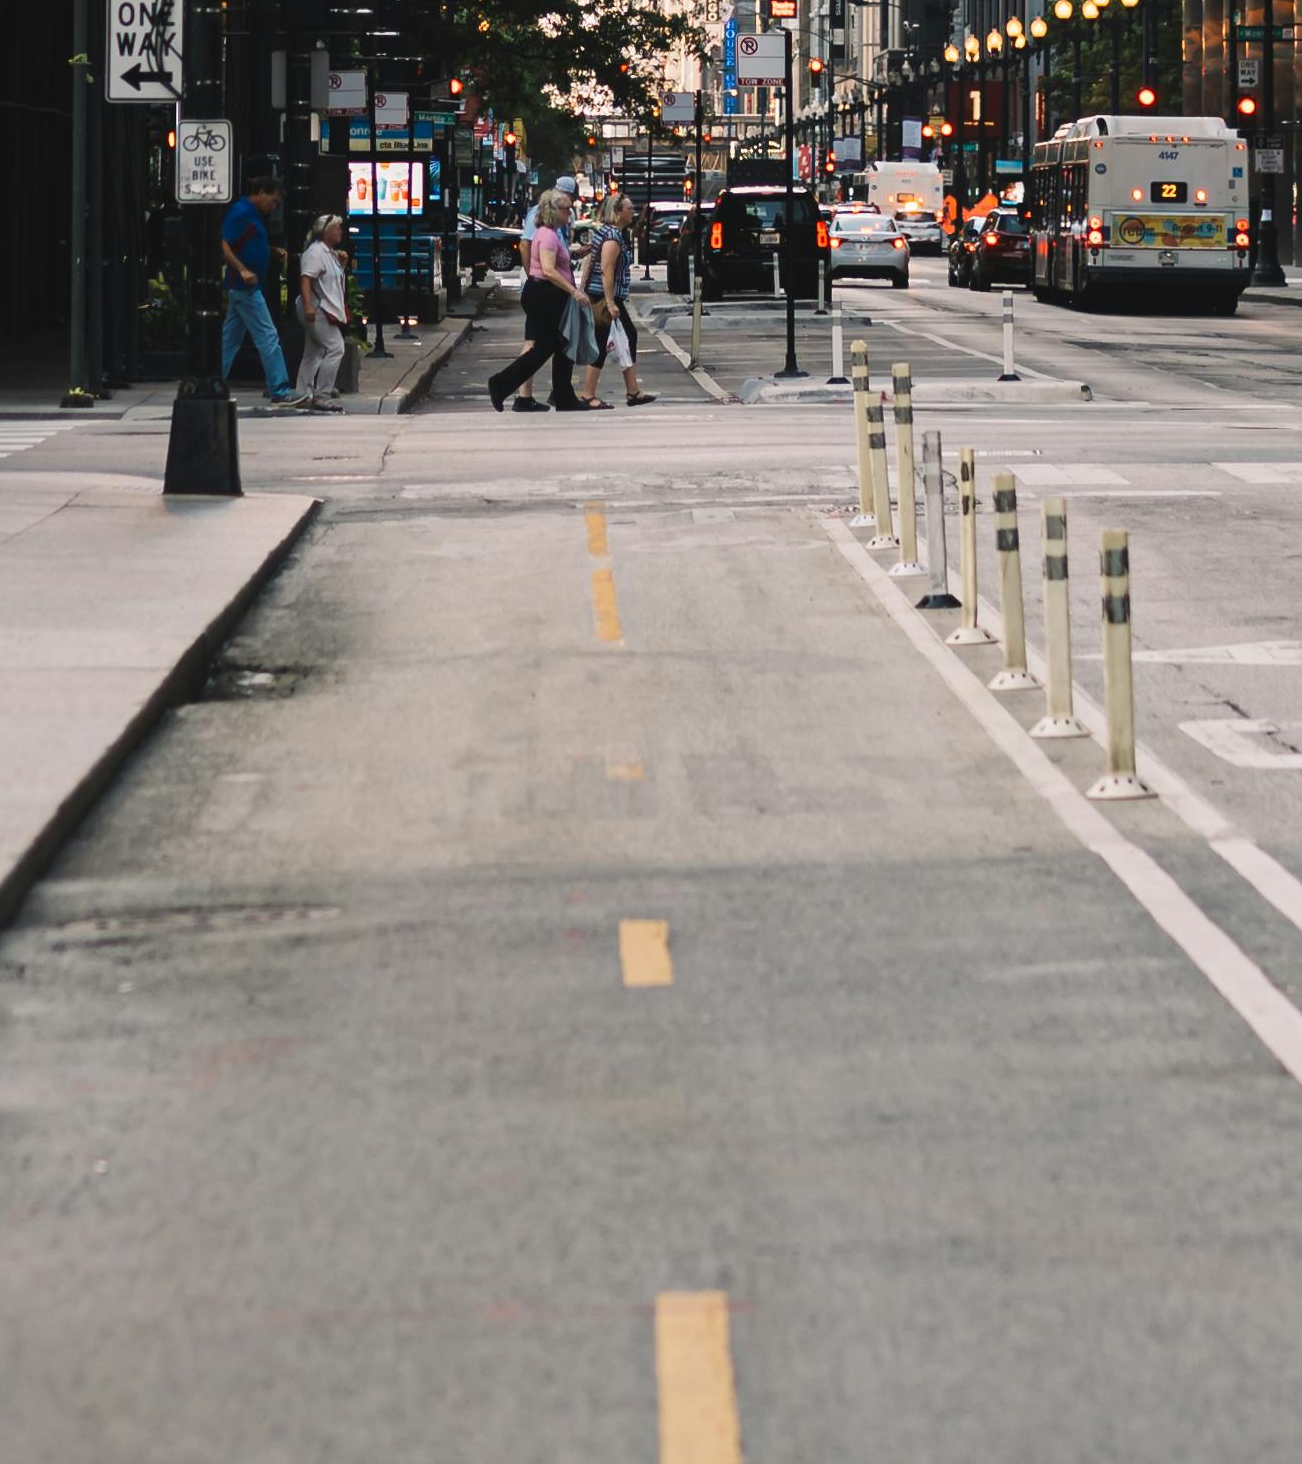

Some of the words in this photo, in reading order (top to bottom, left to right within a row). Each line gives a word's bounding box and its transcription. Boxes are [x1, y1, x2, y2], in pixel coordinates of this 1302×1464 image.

[118, 2, 175, 27] ONE
[116, 32, 176, 57] WAY
[725, 20, 735, 67] HOUSE
[741, 78, 758, 86] TOW
[762, 78, 784, 86] ZONE
[194, 156, 214, 167] USE
[1158, 151, 1179, 160] 4147
[192, 170, 216, 181] BIKE
[1161, 184, 1177, 198] 22
